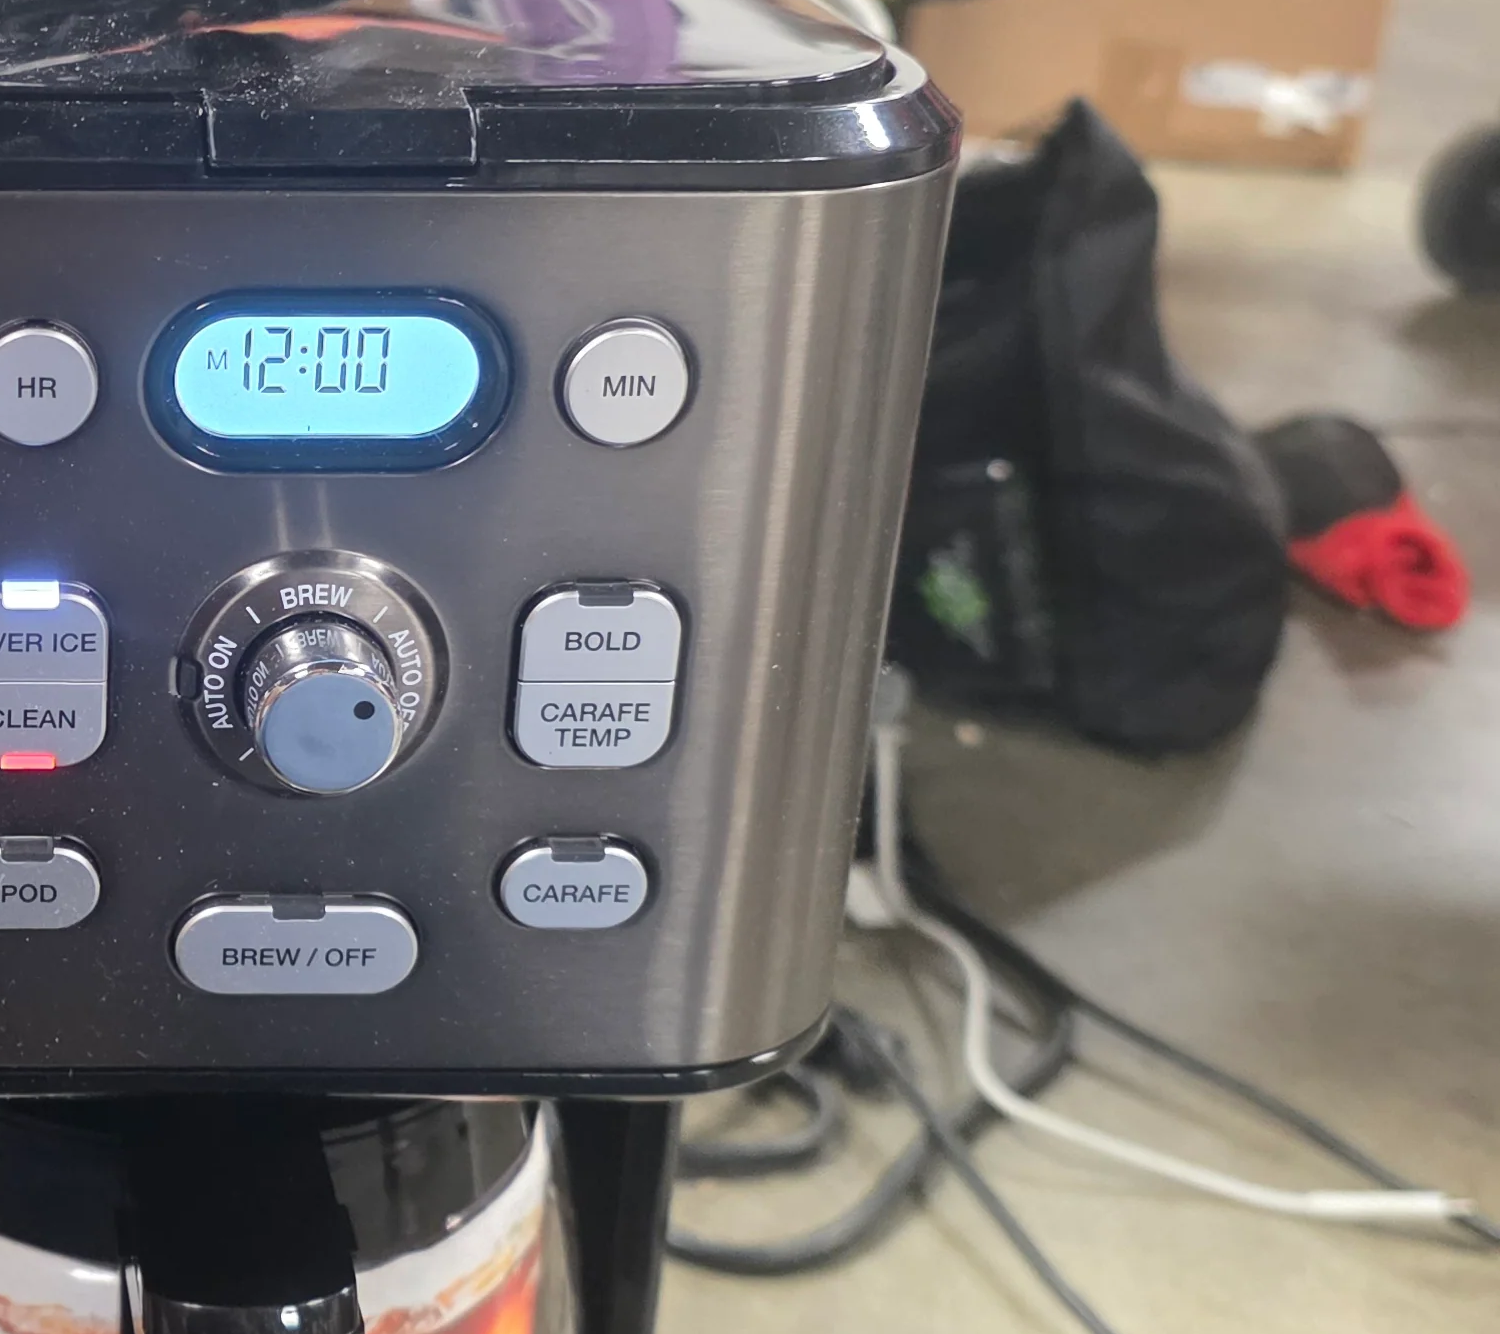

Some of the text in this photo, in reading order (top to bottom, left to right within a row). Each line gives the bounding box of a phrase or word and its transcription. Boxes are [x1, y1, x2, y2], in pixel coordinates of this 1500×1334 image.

[243, 326, 390, 394] 12:00
[17, 376, 57, 399] HR
[602, 375, 656, 397] MIN
[280, 583, 354, 610] BREW
[52, 632, 97, 653] ICE
[564, 631, 641, 652] BOLD
[388, 629, 422, 686] AUTO
[203, 635, 238, 729] AUTO ON
[540, 703, 651, 723] CARAFE
[554, 728, 631, 748] TEMP
[0, 883, 57, 904] POD
[523, 883, 630, 903] CARAFE
[221, 947, 300, 967] BREW
[325, 947, 377, 967] OFF
